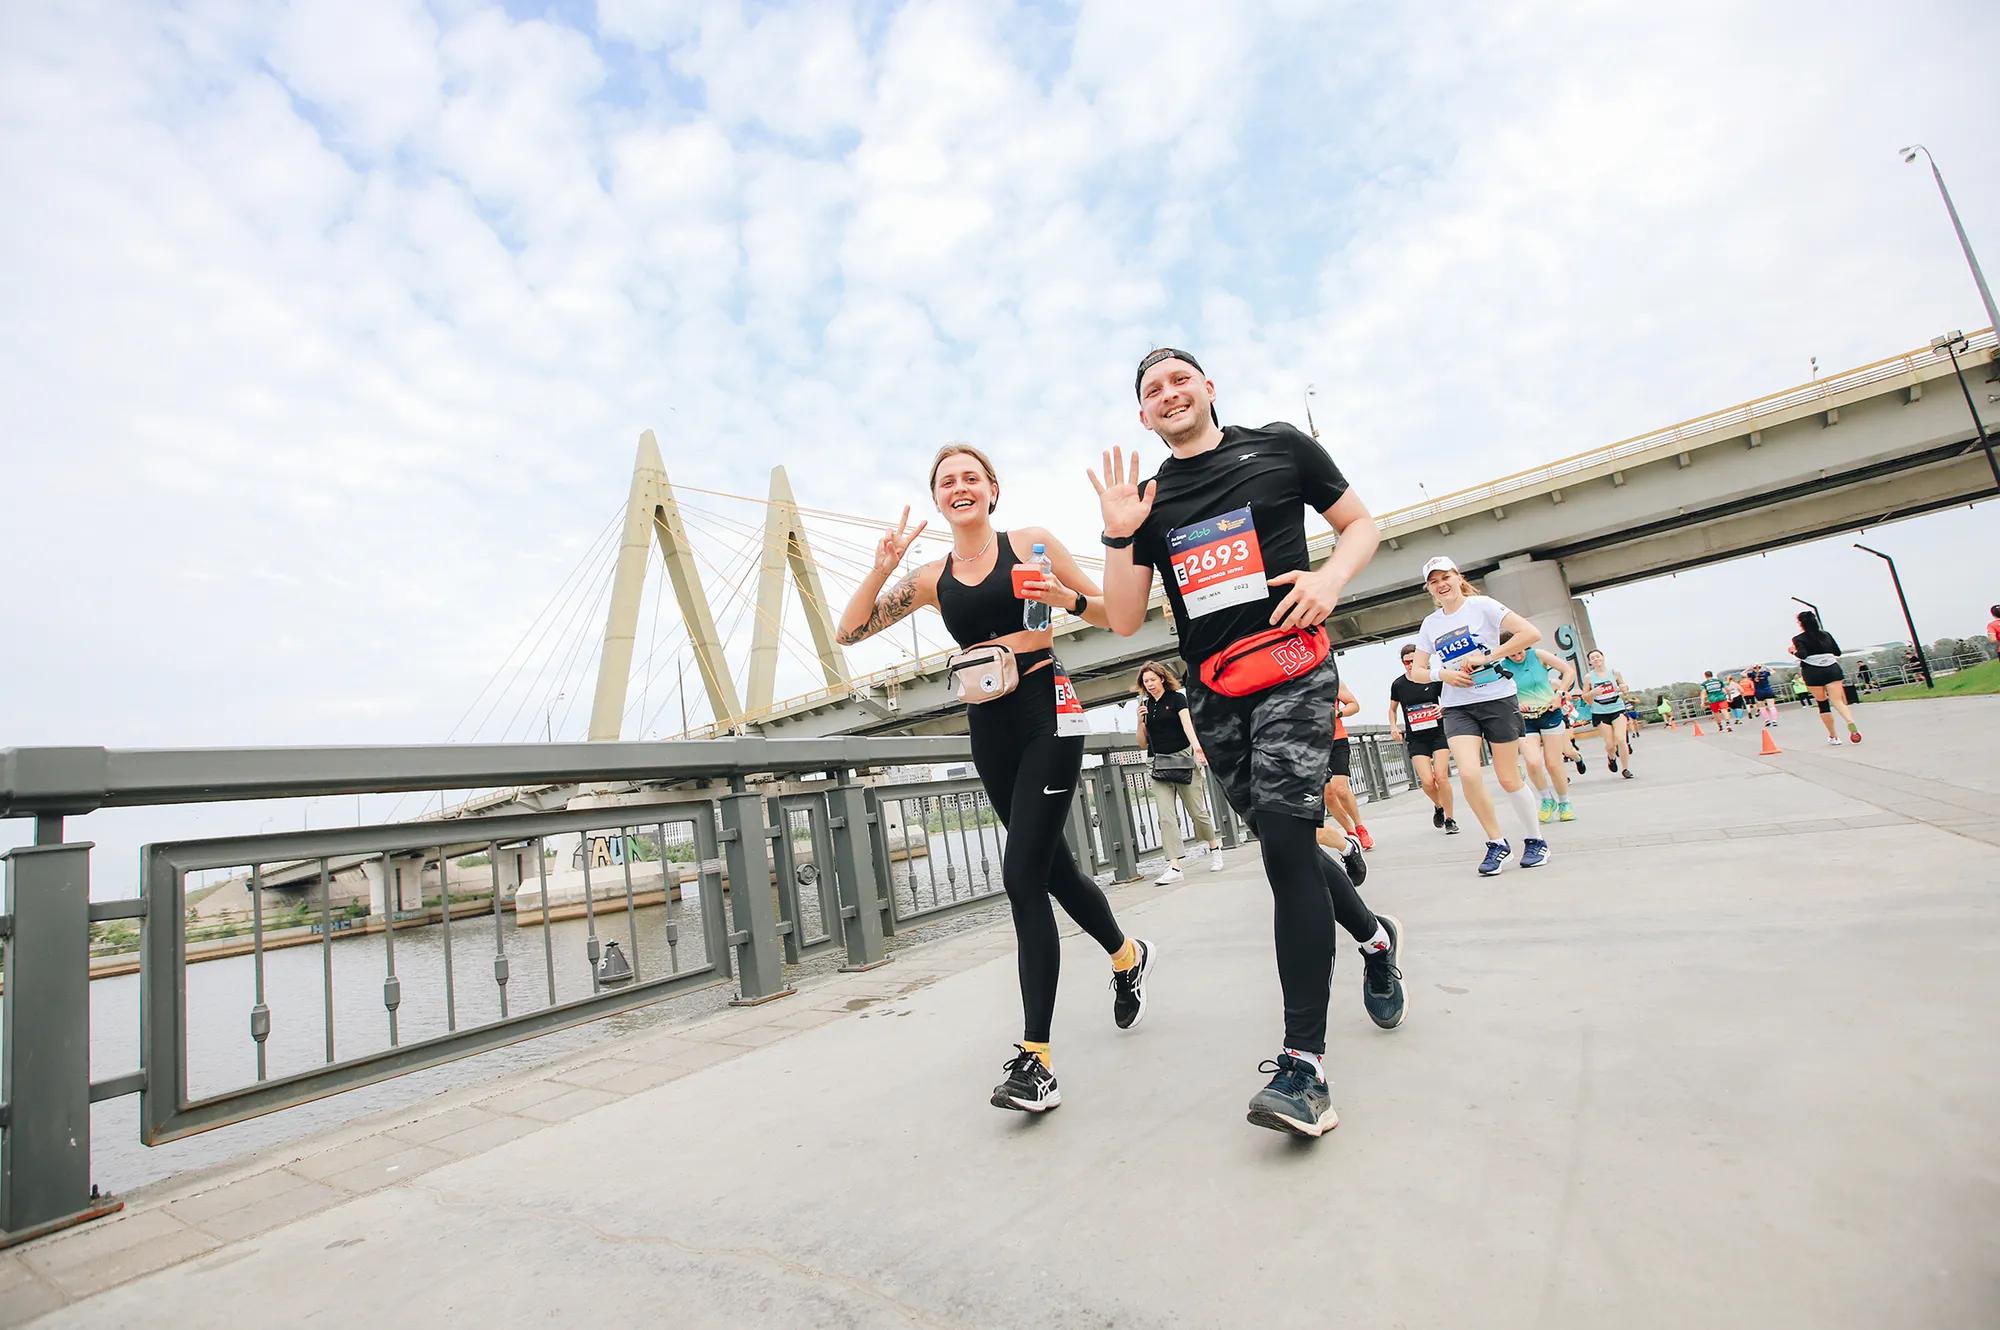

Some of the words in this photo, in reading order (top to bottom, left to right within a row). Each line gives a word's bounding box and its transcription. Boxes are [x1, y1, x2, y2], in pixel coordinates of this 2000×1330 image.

[1178, 568, 1187, 581] E
[1186, 540, 1249, 576] 2693
[1270, 637, 1315, 676] DC
[1443, 638, 1470, 655] 1433
[1058, 690, 1065, 701] E
